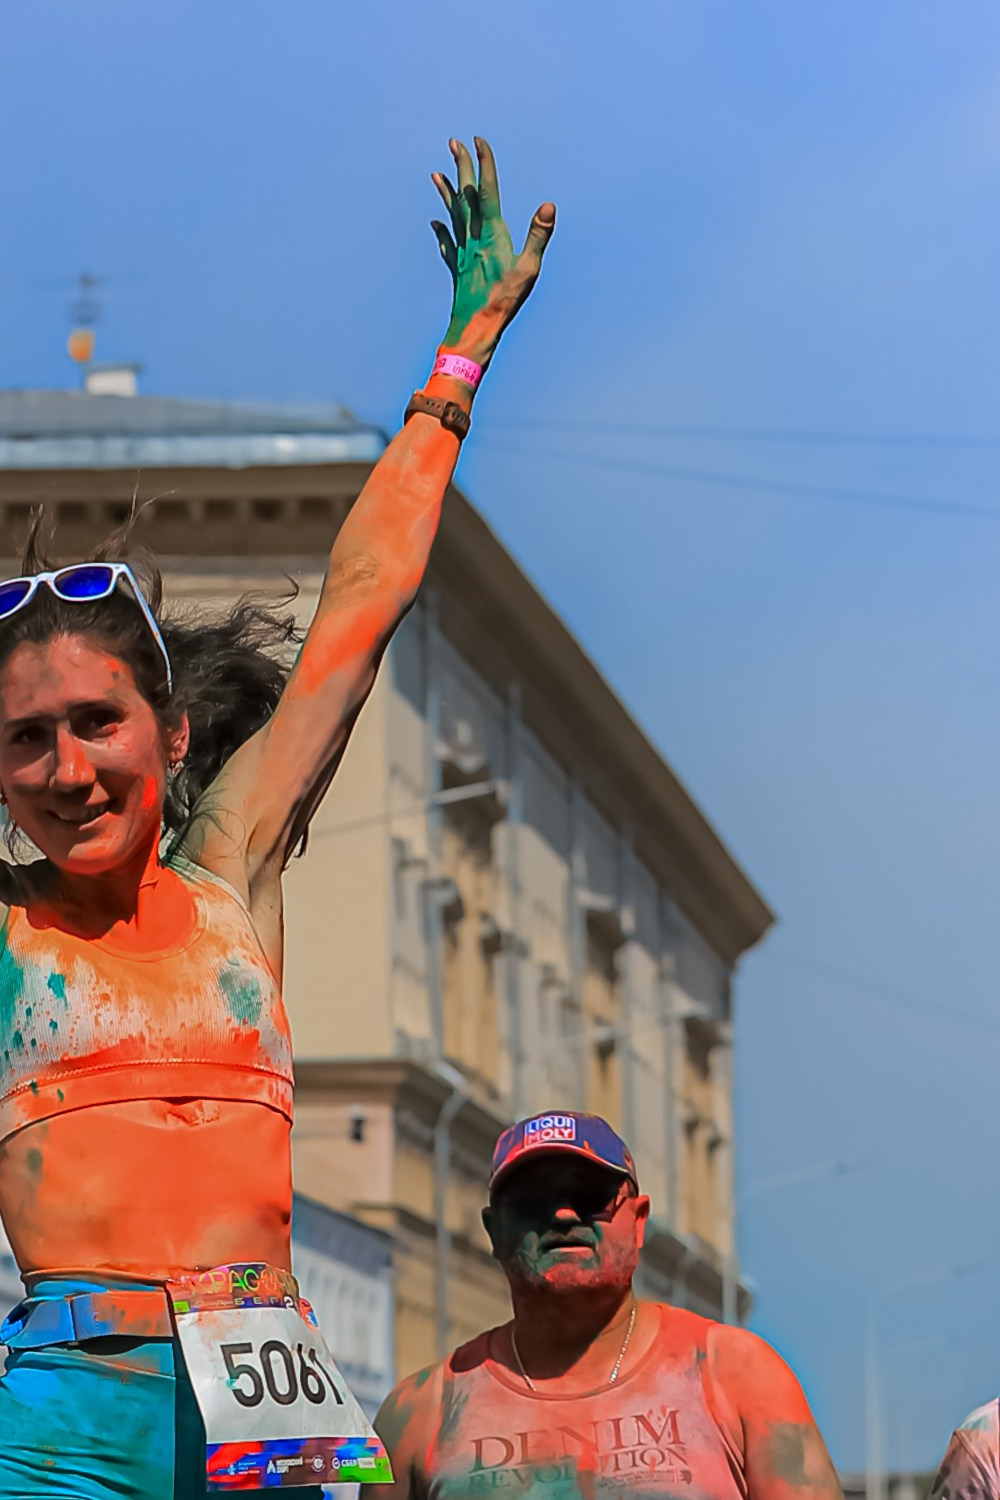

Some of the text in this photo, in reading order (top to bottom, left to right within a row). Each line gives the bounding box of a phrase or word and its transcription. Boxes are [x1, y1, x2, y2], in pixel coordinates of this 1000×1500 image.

[528, 1116, 572, 1133] LIQUI
[528, 1128, 572, 1145] MOLY
[220, 1339, 344, 1408] 5061
[468, 1409, 687, 1475] DENIM
